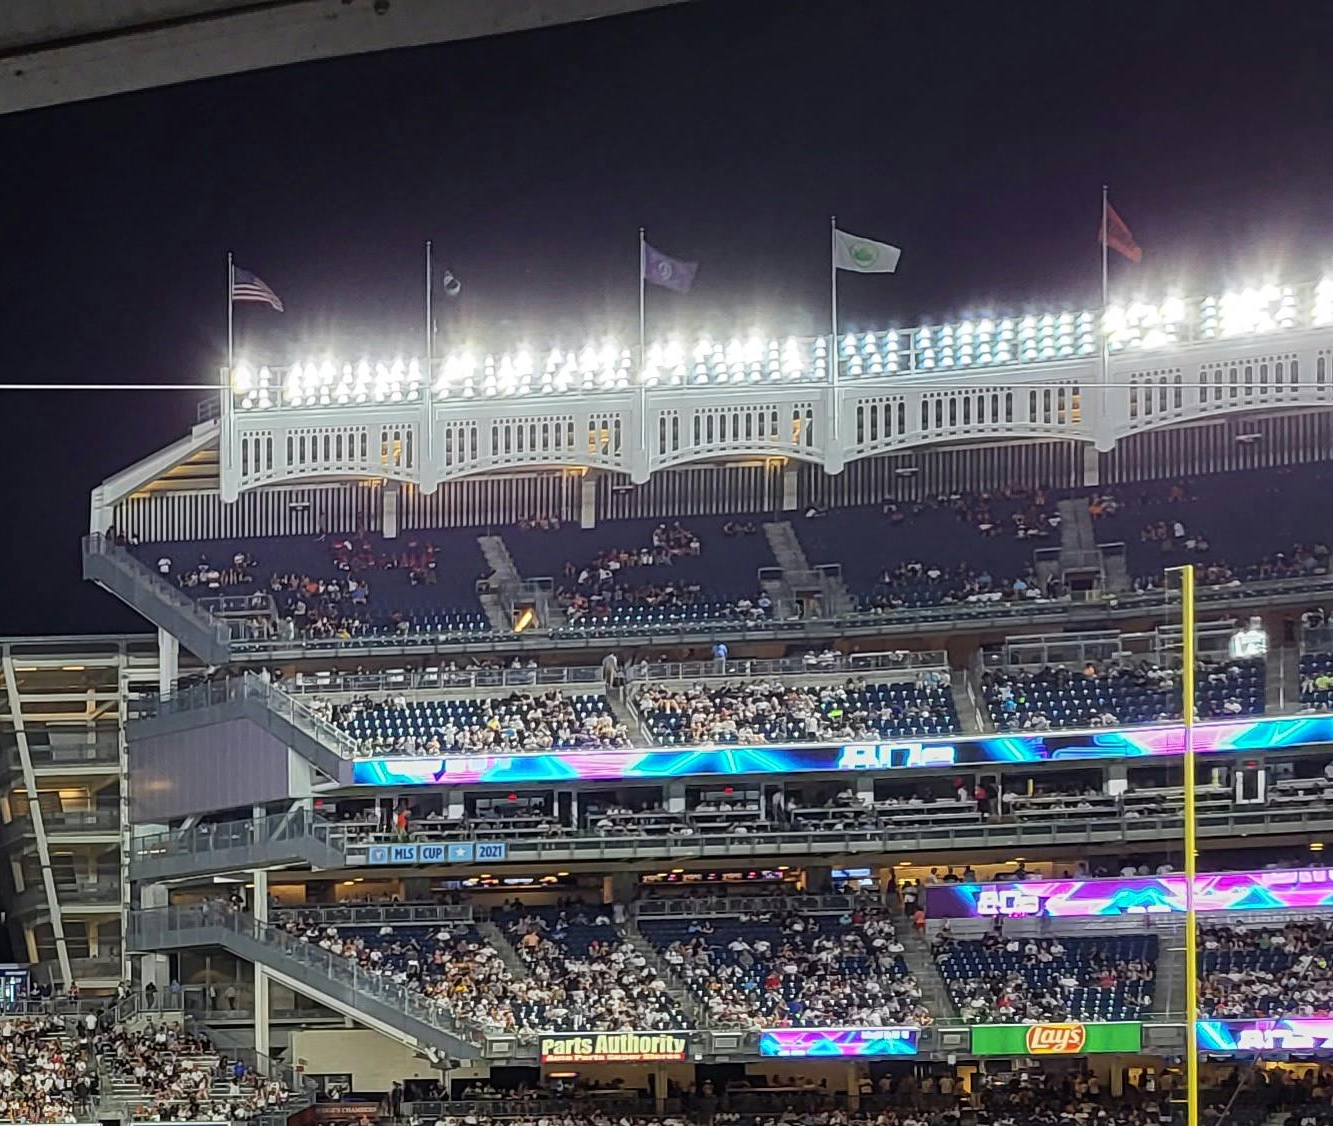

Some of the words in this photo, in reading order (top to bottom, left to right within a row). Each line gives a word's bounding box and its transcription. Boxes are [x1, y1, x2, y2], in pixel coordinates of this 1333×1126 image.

[394, 847, 414, 860] MLS
[421, 847, 442, 860] CUP
[478, 845, 502, 858] 2021
[541, 1037, 593, 1056] Parts
[595, 1034, 685, 1056] Authority
